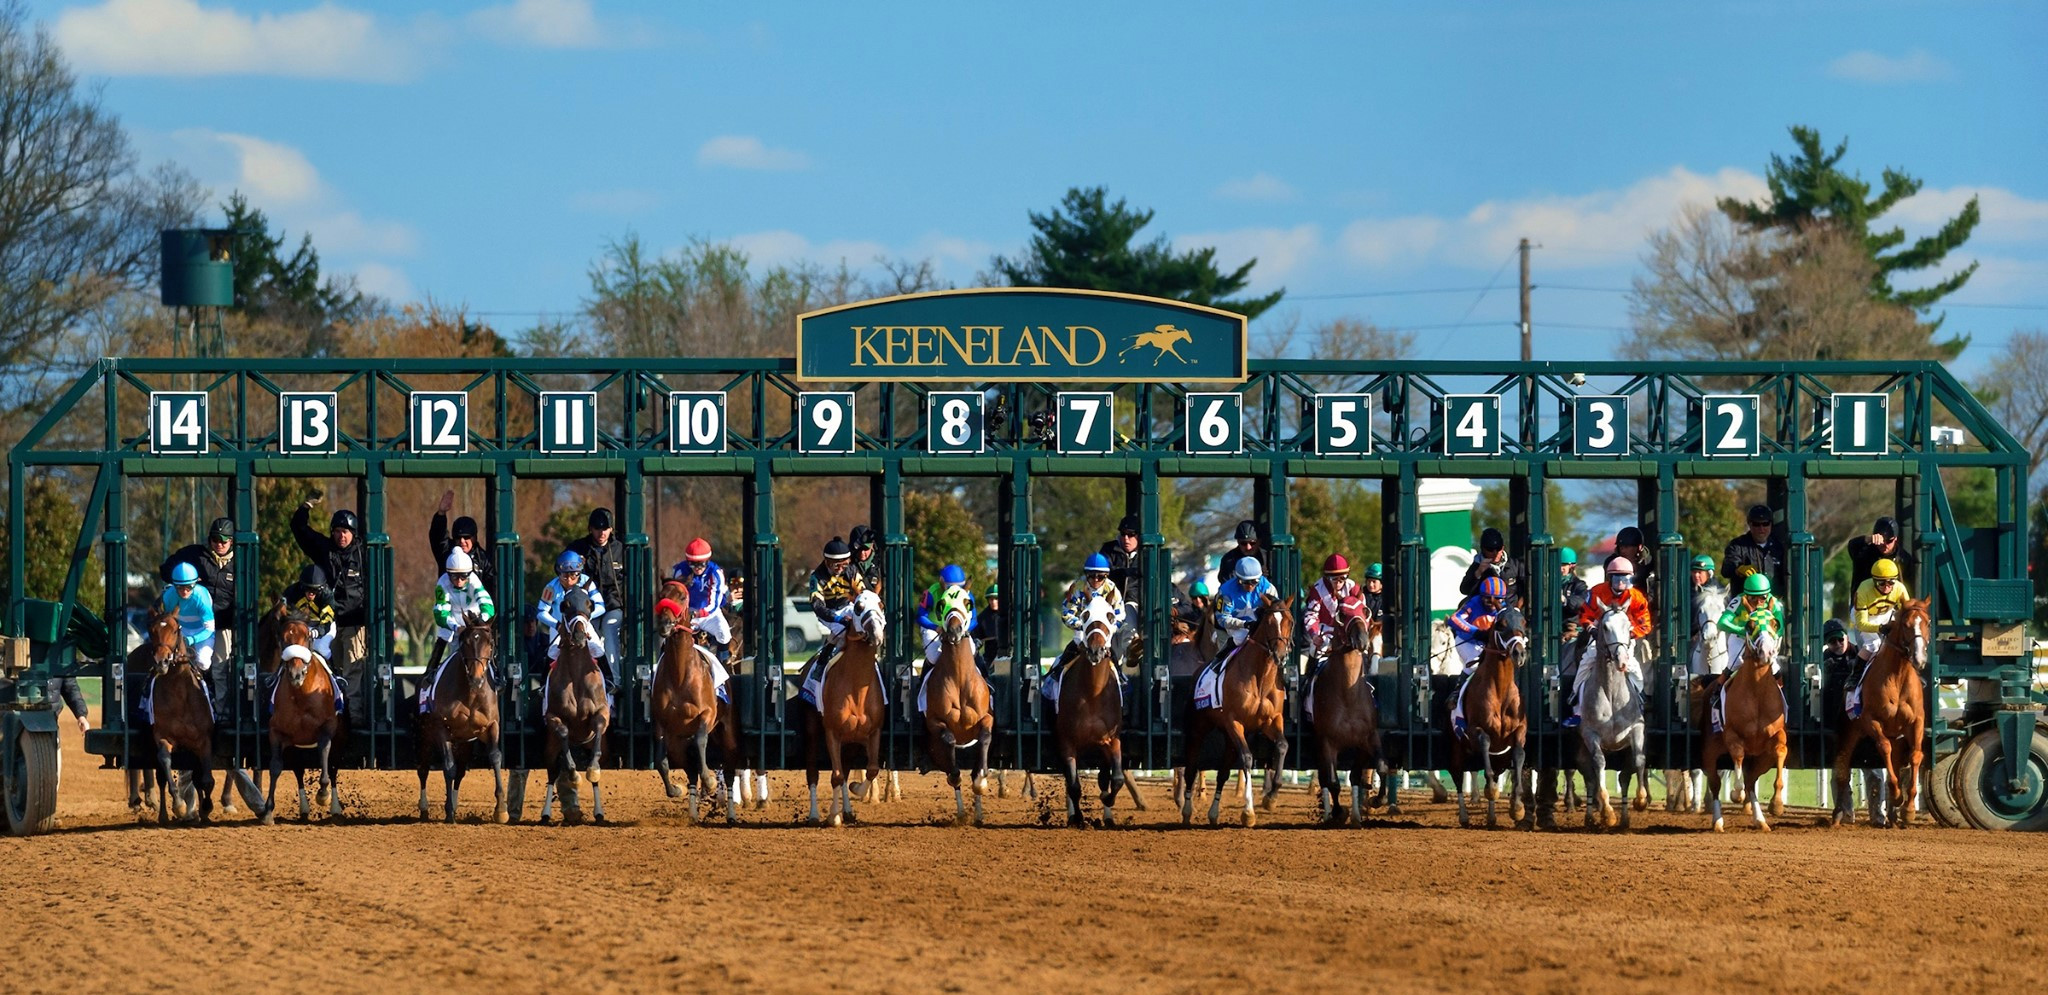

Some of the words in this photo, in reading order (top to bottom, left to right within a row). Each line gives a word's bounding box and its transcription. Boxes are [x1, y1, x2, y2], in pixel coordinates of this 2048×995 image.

[850, 325, 1107, 367] KEENELAND
[160, 400, 201, 446] 14
[291, 400, 329, 446] 13
[421, 400, 460, 446] 12
[555, 400, 584, 445] 11
[678, 400, 719, 446] 10
[812, 400, 843, 446] 9
[940, 400, 971, 446] 8
[1071, 400, 1100, 446] 7
[1199, 400, 1230, 447] 6
[1331, 401, 1357, 448] 5
[1456, 402, 1488, 447] 4
[1589, 402, 1615, 448] 3
[1717, 402, 1747, 448] 2
[1854, 402, 1866, 447] 1
[543, 588, 553, 601] 11
[1216, 598, 1223, 610] 6
[1729, 599, 1739, 609] 2
